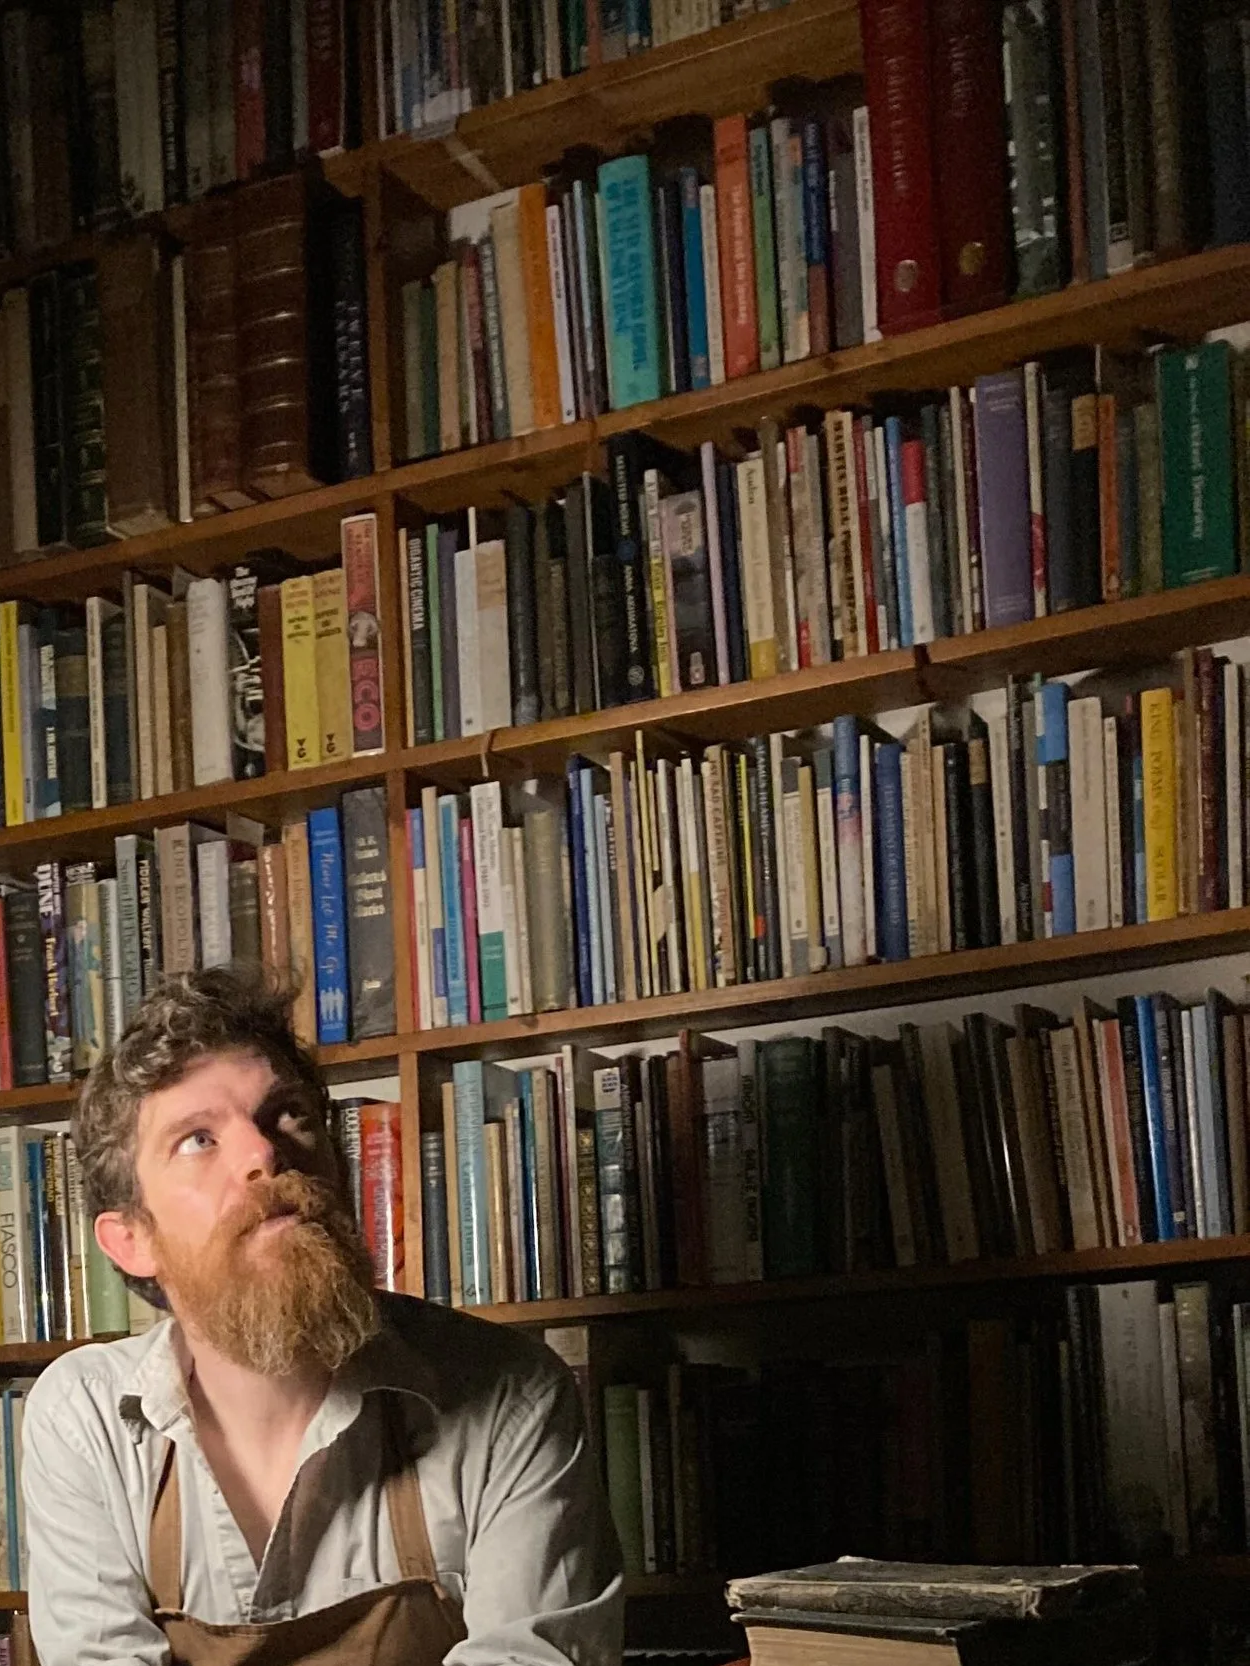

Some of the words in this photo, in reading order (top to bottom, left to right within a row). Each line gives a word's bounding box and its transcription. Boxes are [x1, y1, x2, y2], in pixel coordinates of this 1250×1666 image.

[408, 538, 422, 588] GIGANTIC
[410, 589, 424, 631] CINEMA
[755, 744, 766, 788] SEAMUS
[758, 791, 769, 837] HEANEY
[120, 858, 133, 893] Susan
[172, 838, 185, 879] KING
[320, 851, 336, 888] Never
[36, 863, 53, 916] DUNE
[122, 896, 137, 918] Hill
[321, 895, 337, 917] Let
[45, 936, 57, 971] Frank
[324, 924, 339, 947] Me
[318, 956, 339, 975] Go
[47, 972, 60, 1017] Herbert
[345, 1106, 361, 1160] DOCHERTY
[0, 1213, 18, 1289] FIASCO
